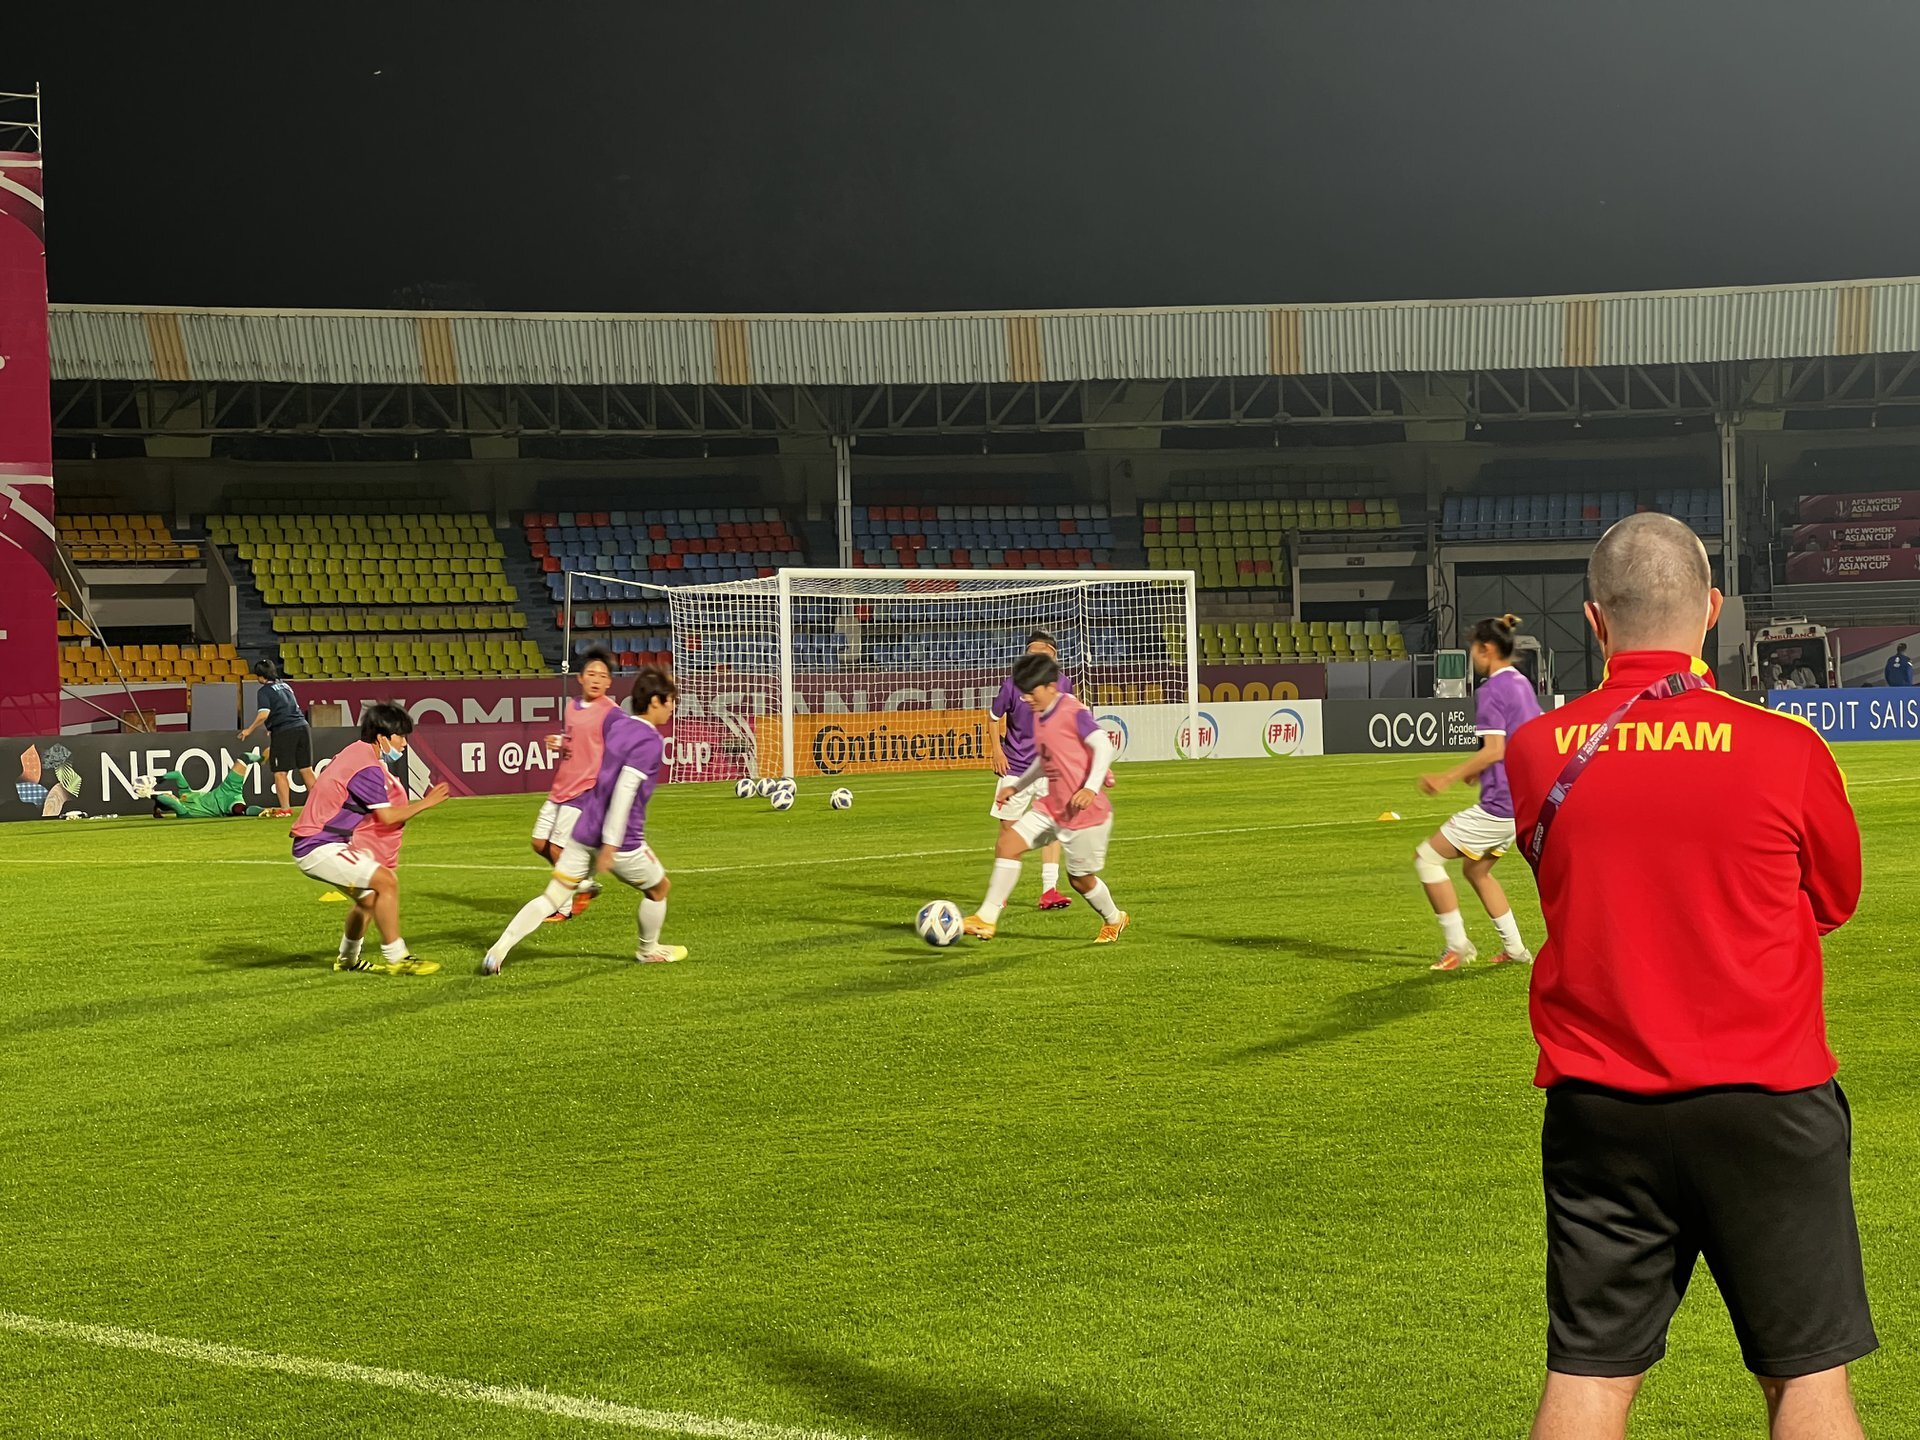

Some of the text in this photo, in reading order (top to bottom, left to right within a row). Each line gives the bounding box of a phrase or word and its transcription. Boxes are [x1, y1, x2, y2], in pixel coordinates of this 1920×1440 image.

[1839, 562, 1867, 570] ASIAN
[1764, 632, 1817, 641] AMBULANCE
[1448, 711, 1465, 722] AFC
[1268, 723, 1298, 744] 伊利
[1368, 712, 1438, 748] ace
[1448, 734, 1457, 746] of
[813, 723, 984, 775] Continental
